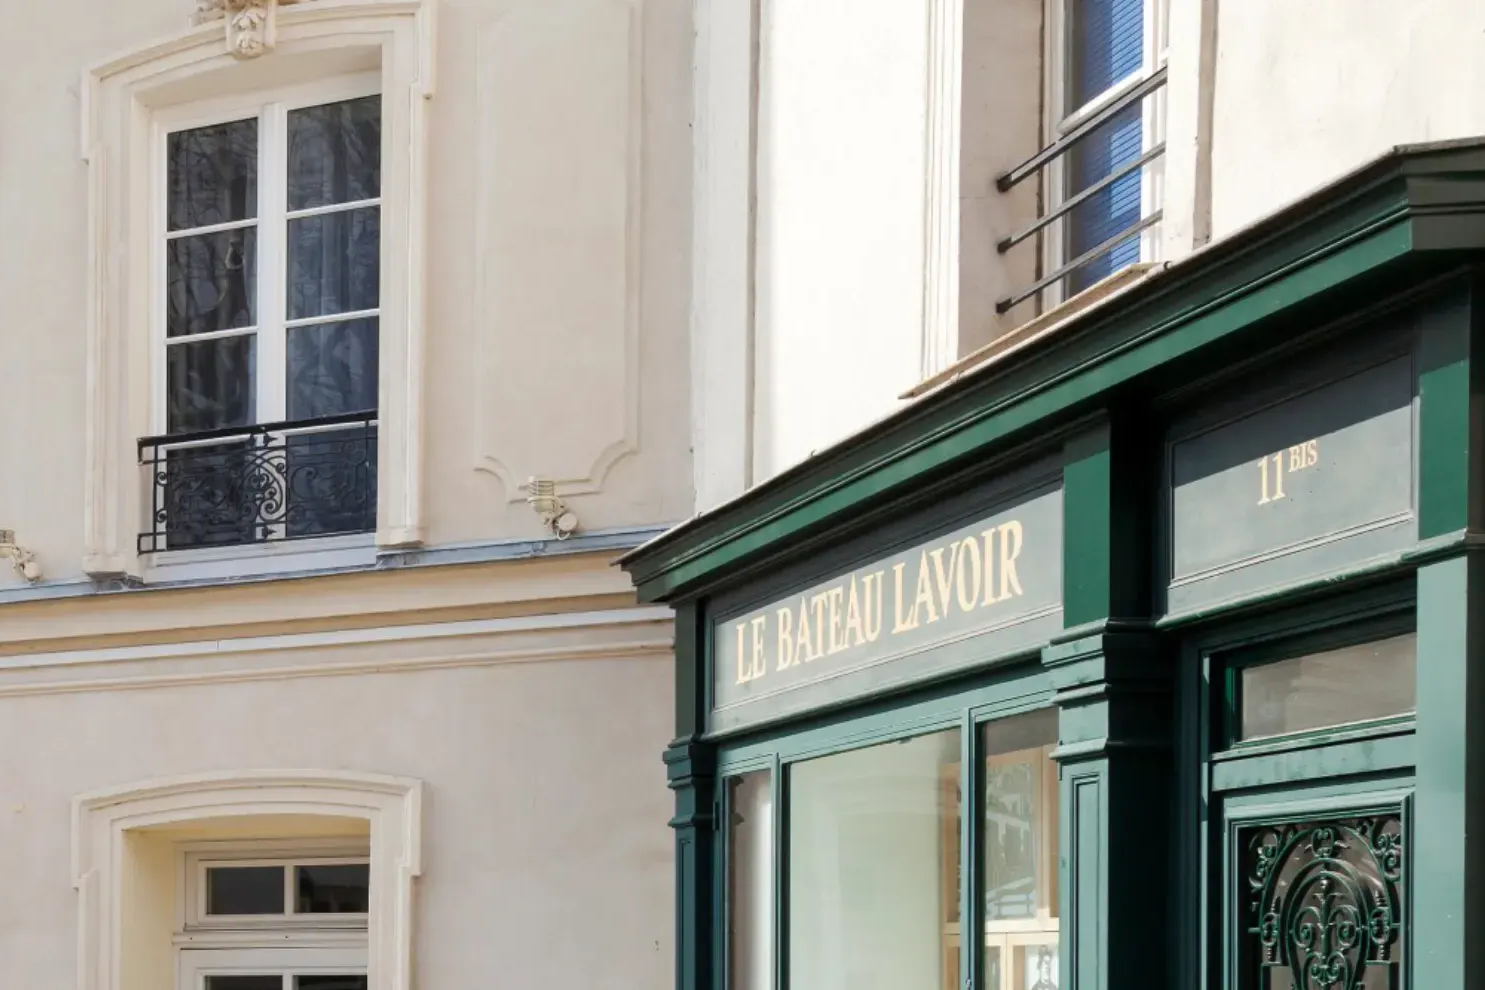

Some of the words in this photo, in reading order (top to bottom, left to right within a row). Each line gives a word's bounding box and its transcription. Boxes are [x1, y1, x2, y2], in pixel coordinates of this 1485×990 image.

[1257, 450, 1286, 506] 11
[1288, 438, 1317, 473] BIS
[735, 614, 767, 686] LE
[776, 570, 885, 672] BATEAU
[891, 519, 1024, 635] LAVOIR
